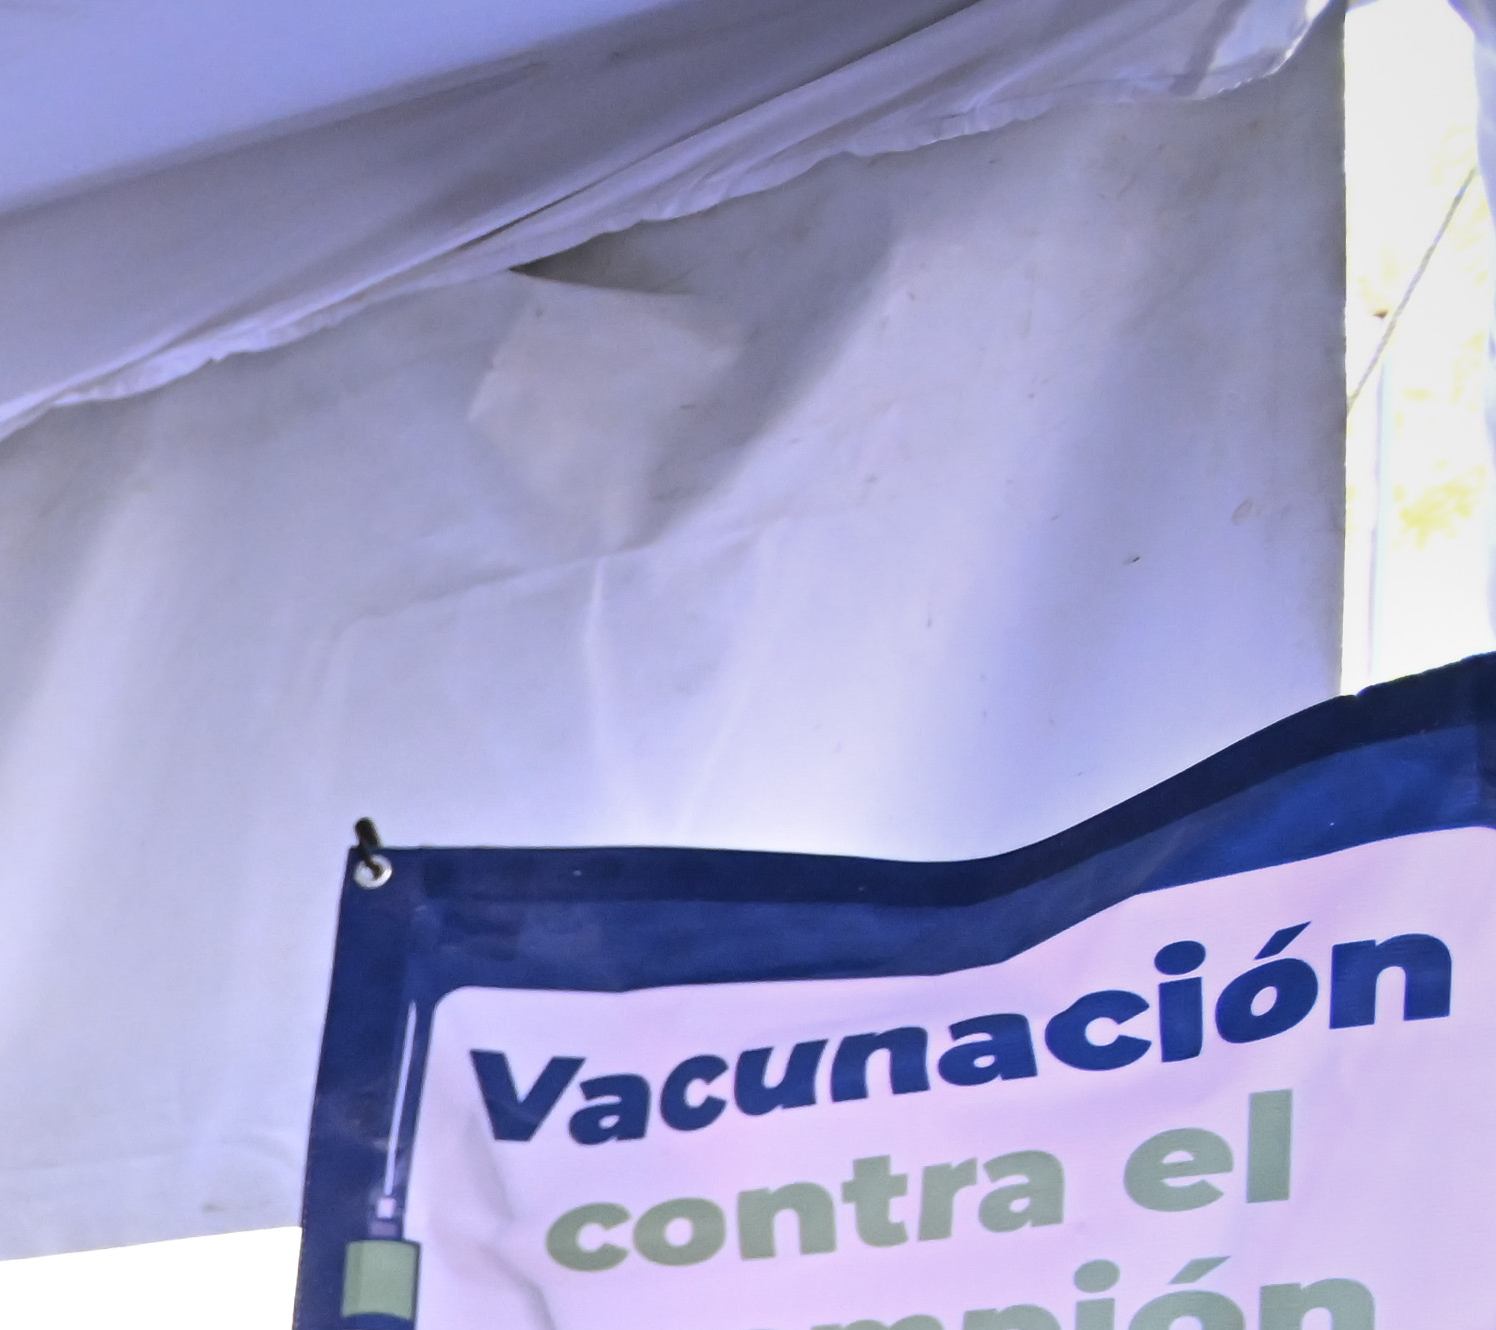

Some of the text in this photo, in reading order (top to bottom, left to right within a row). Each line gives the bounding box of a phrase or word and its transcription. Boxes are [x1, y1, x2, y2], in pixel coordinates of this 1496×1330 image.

[470, 923, 1453, 1144] Vacunación
[546, 1090, 1290, 1272] contra el
